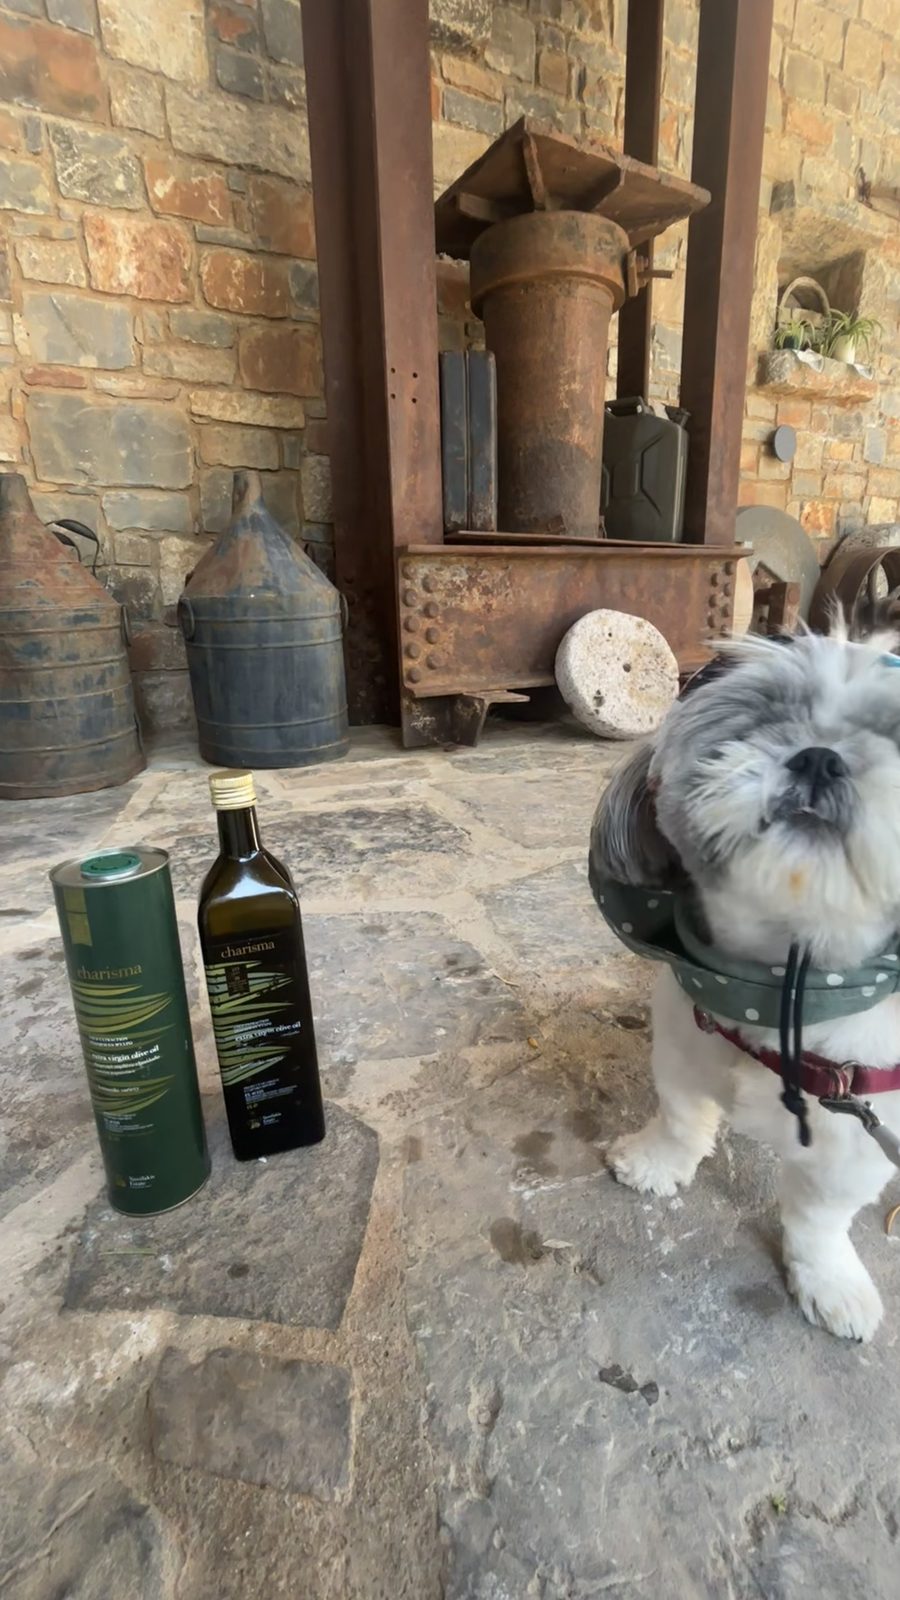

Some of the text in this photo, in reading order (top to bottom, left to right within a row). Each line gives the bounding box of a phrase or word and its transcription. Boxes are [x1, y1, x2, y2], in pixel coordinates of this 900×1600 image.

[221, 941, 275, 958] charisma
[77, 964, 143, 980] charisma
[275, 1024, 292, 1033] olive
[292, 1020, 301, 1029] oil
[107, 1053, 130, 1063] virgin
[130, 1050, 149, 1060] olive
[149, 1044, 160, 1054] oil
